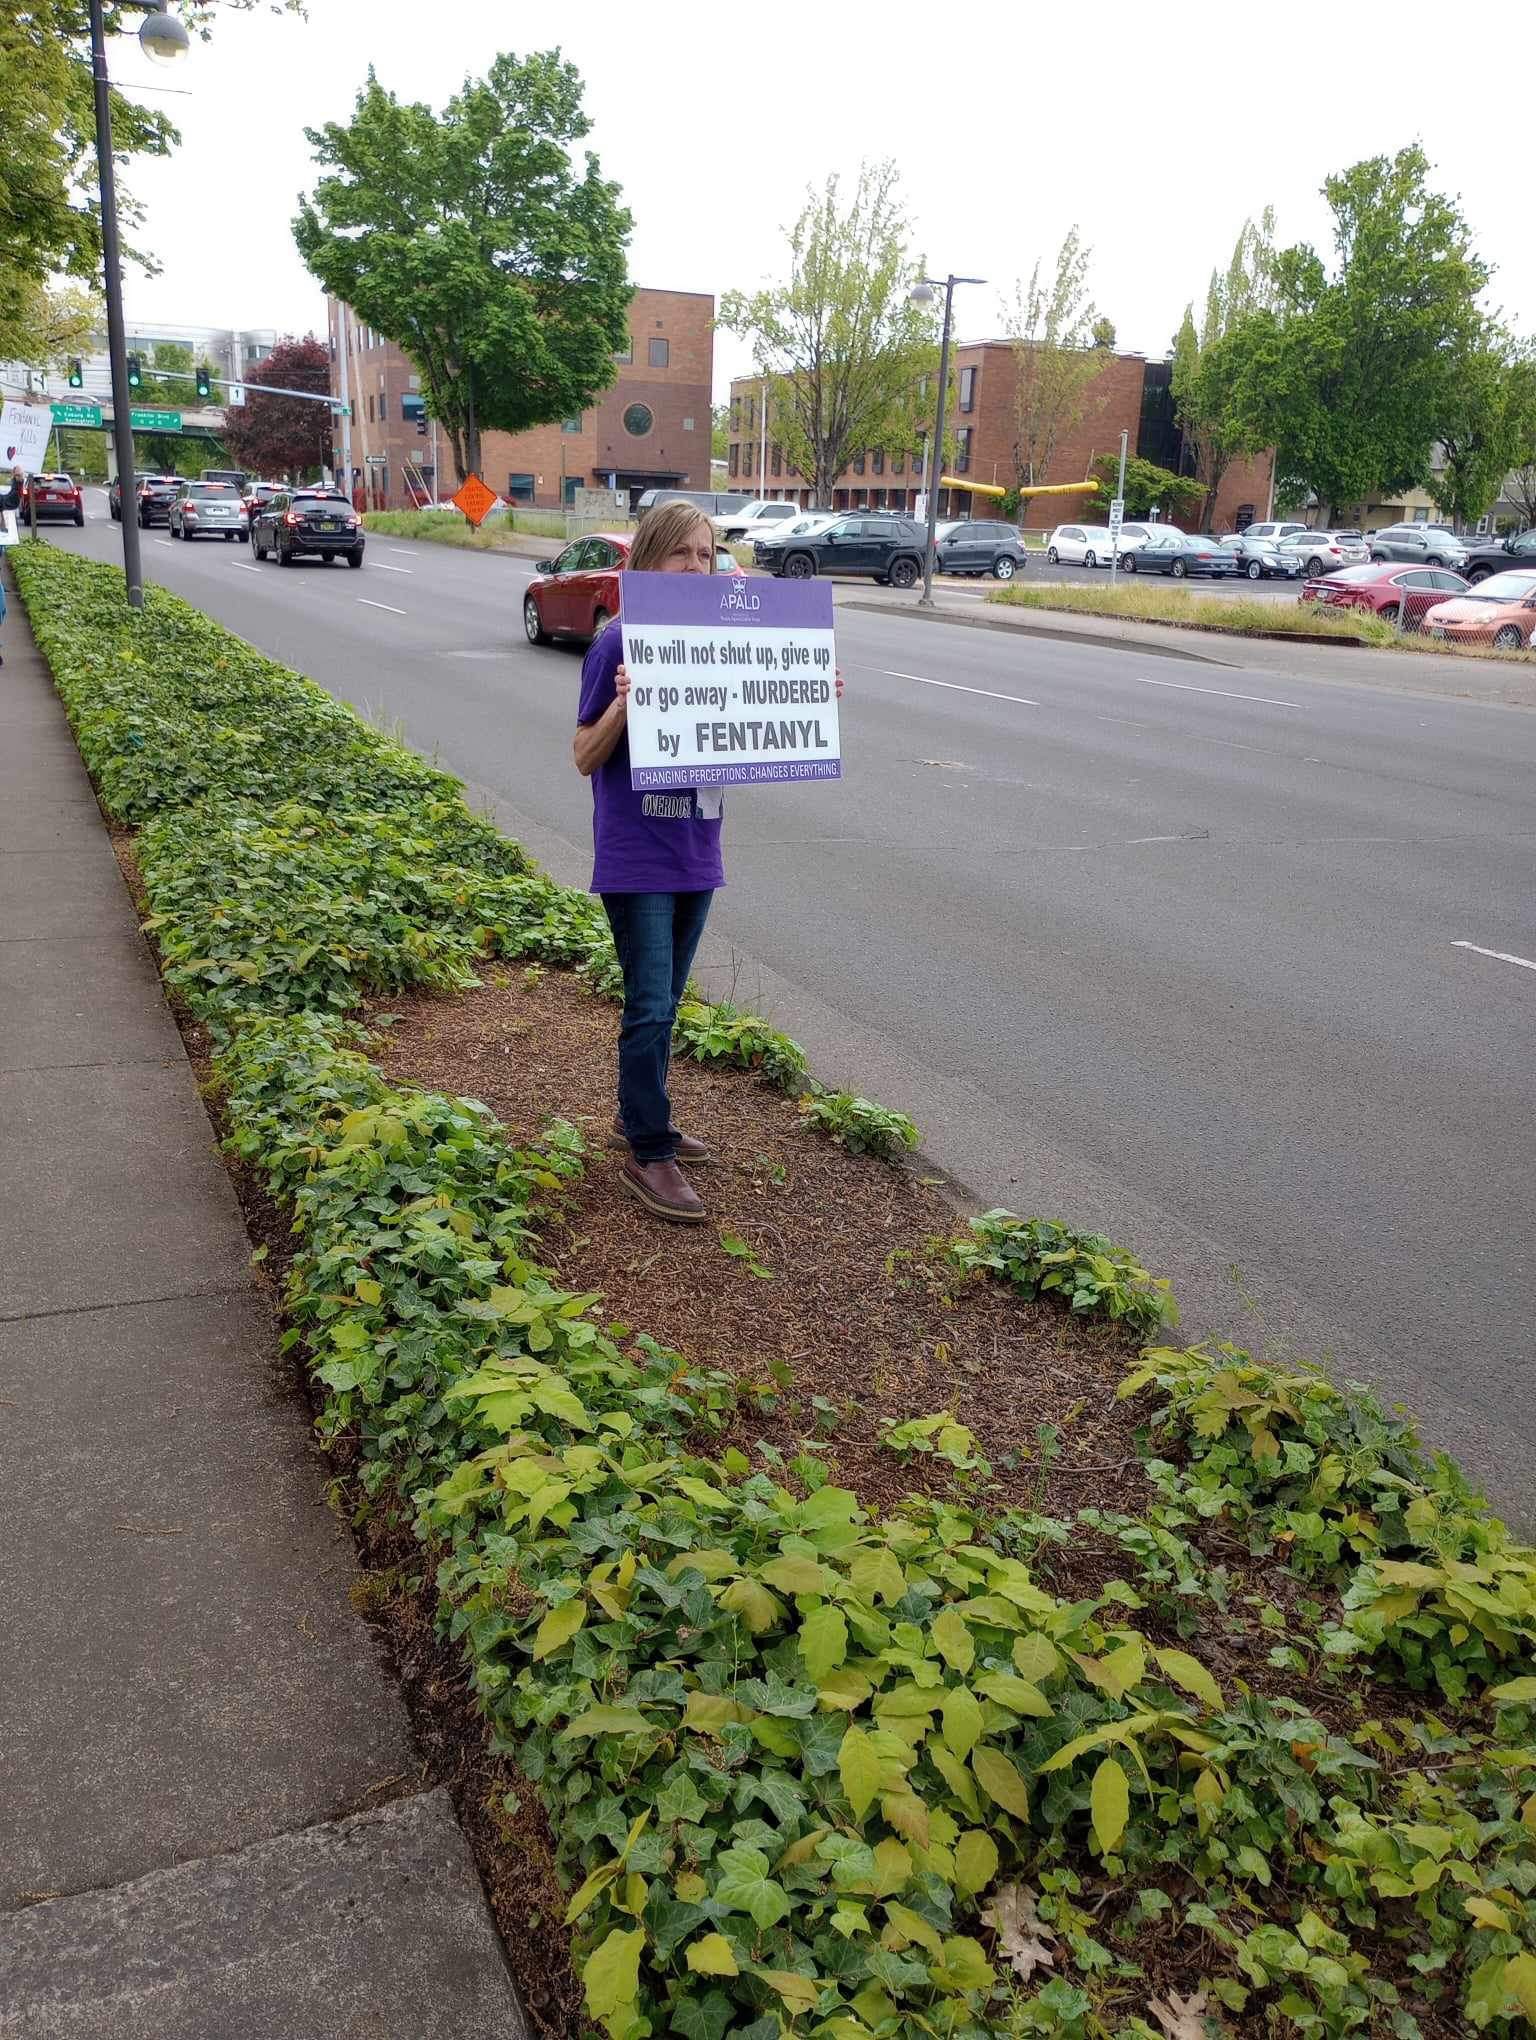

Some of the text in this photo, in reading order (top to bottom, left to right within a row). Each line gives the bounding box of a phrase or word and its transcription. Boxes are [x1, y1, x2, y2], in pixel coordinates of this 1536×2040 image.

[720, 594, 760, 610] APALD
[629, 639, 830, 671] We will not shut up, give up
[635, 688, 652, 706] or
[659, 687, 678, 712] go
[685, 687, 727, 711] away
[743, 680, 830, 704] MURDERED
[658, 720, 828, 757] by FENTANYL
[640, 763, 839, 785] CHANGING PERCEPTIONS. CHANGES EVERYTHING.
